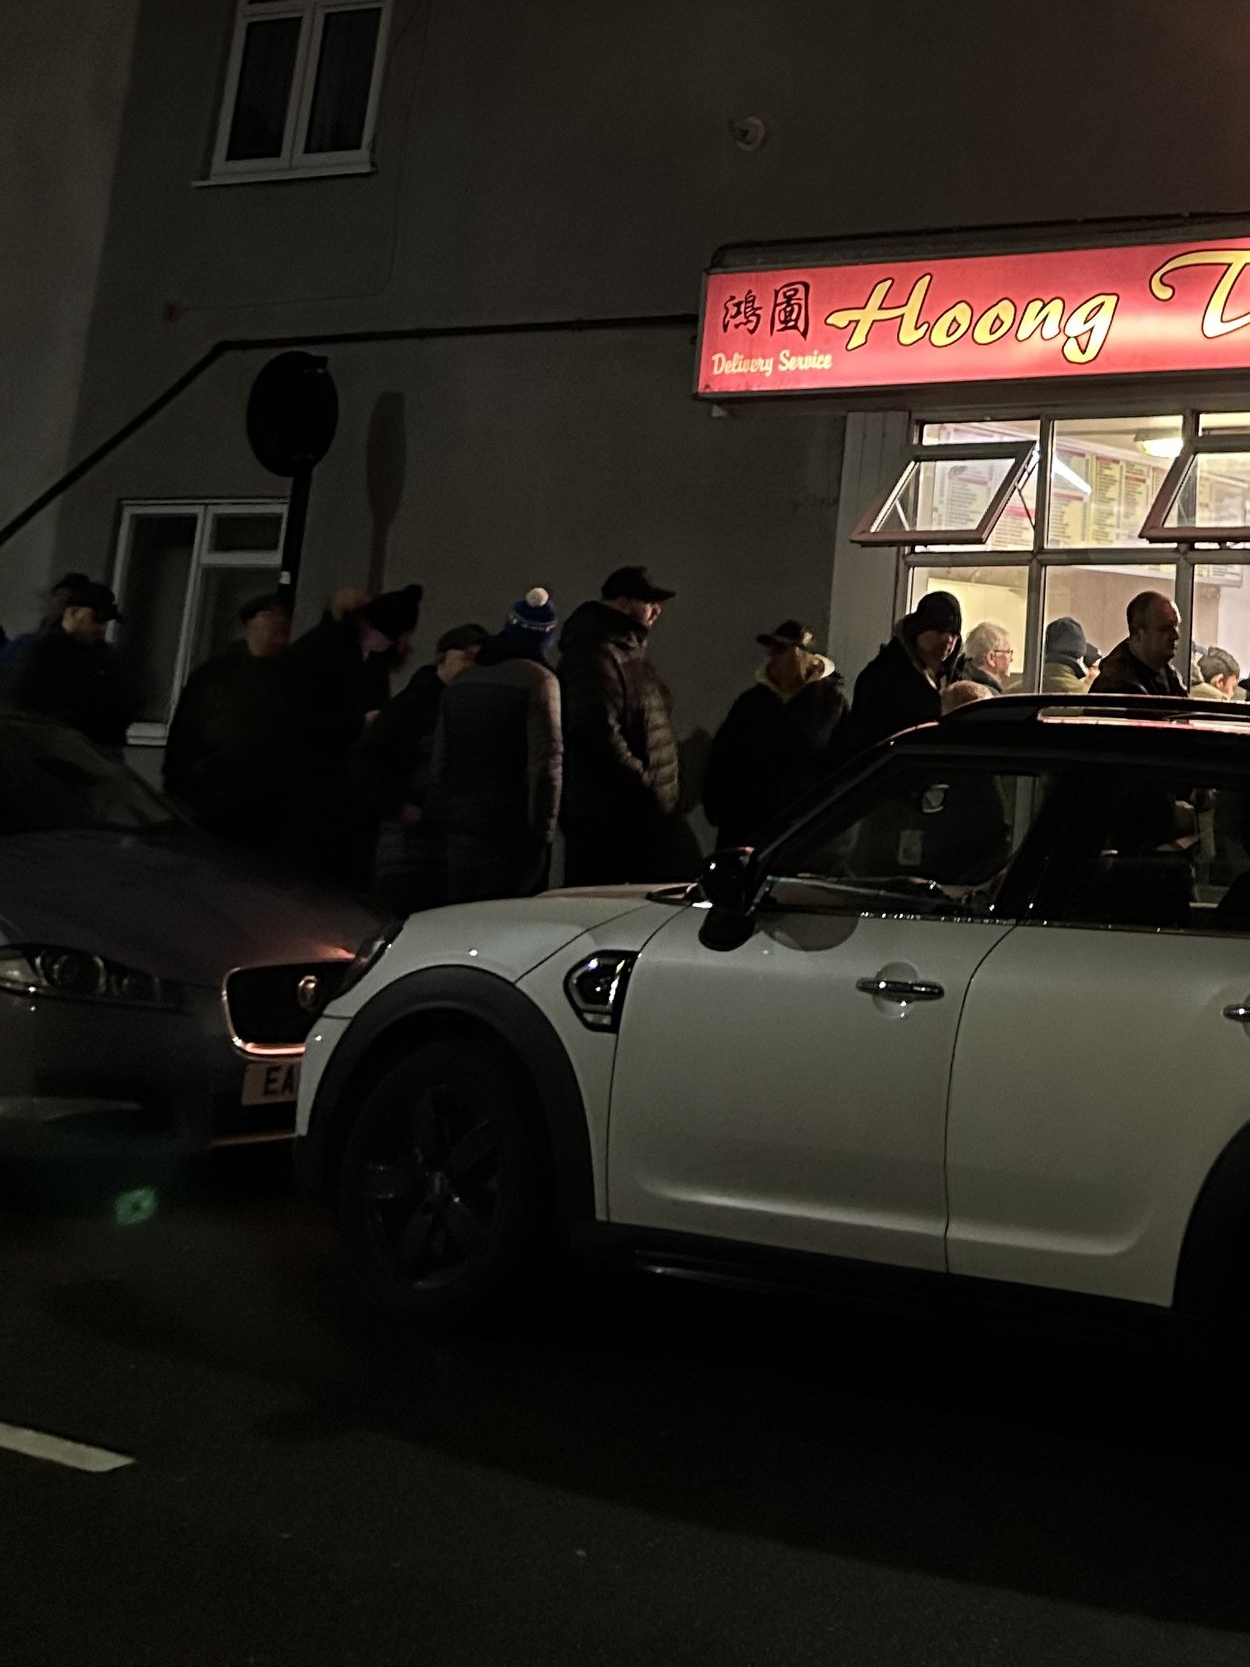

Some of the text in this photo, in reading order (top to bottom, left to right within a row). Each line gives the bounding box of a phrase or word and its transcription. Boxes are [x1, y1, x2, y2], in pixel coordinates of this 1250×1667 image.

[722, 281, 810, 341] 鴻圖
[825, 273, 1119, 364] Hoong
[712, 349, 832, 377] Delivery Service
